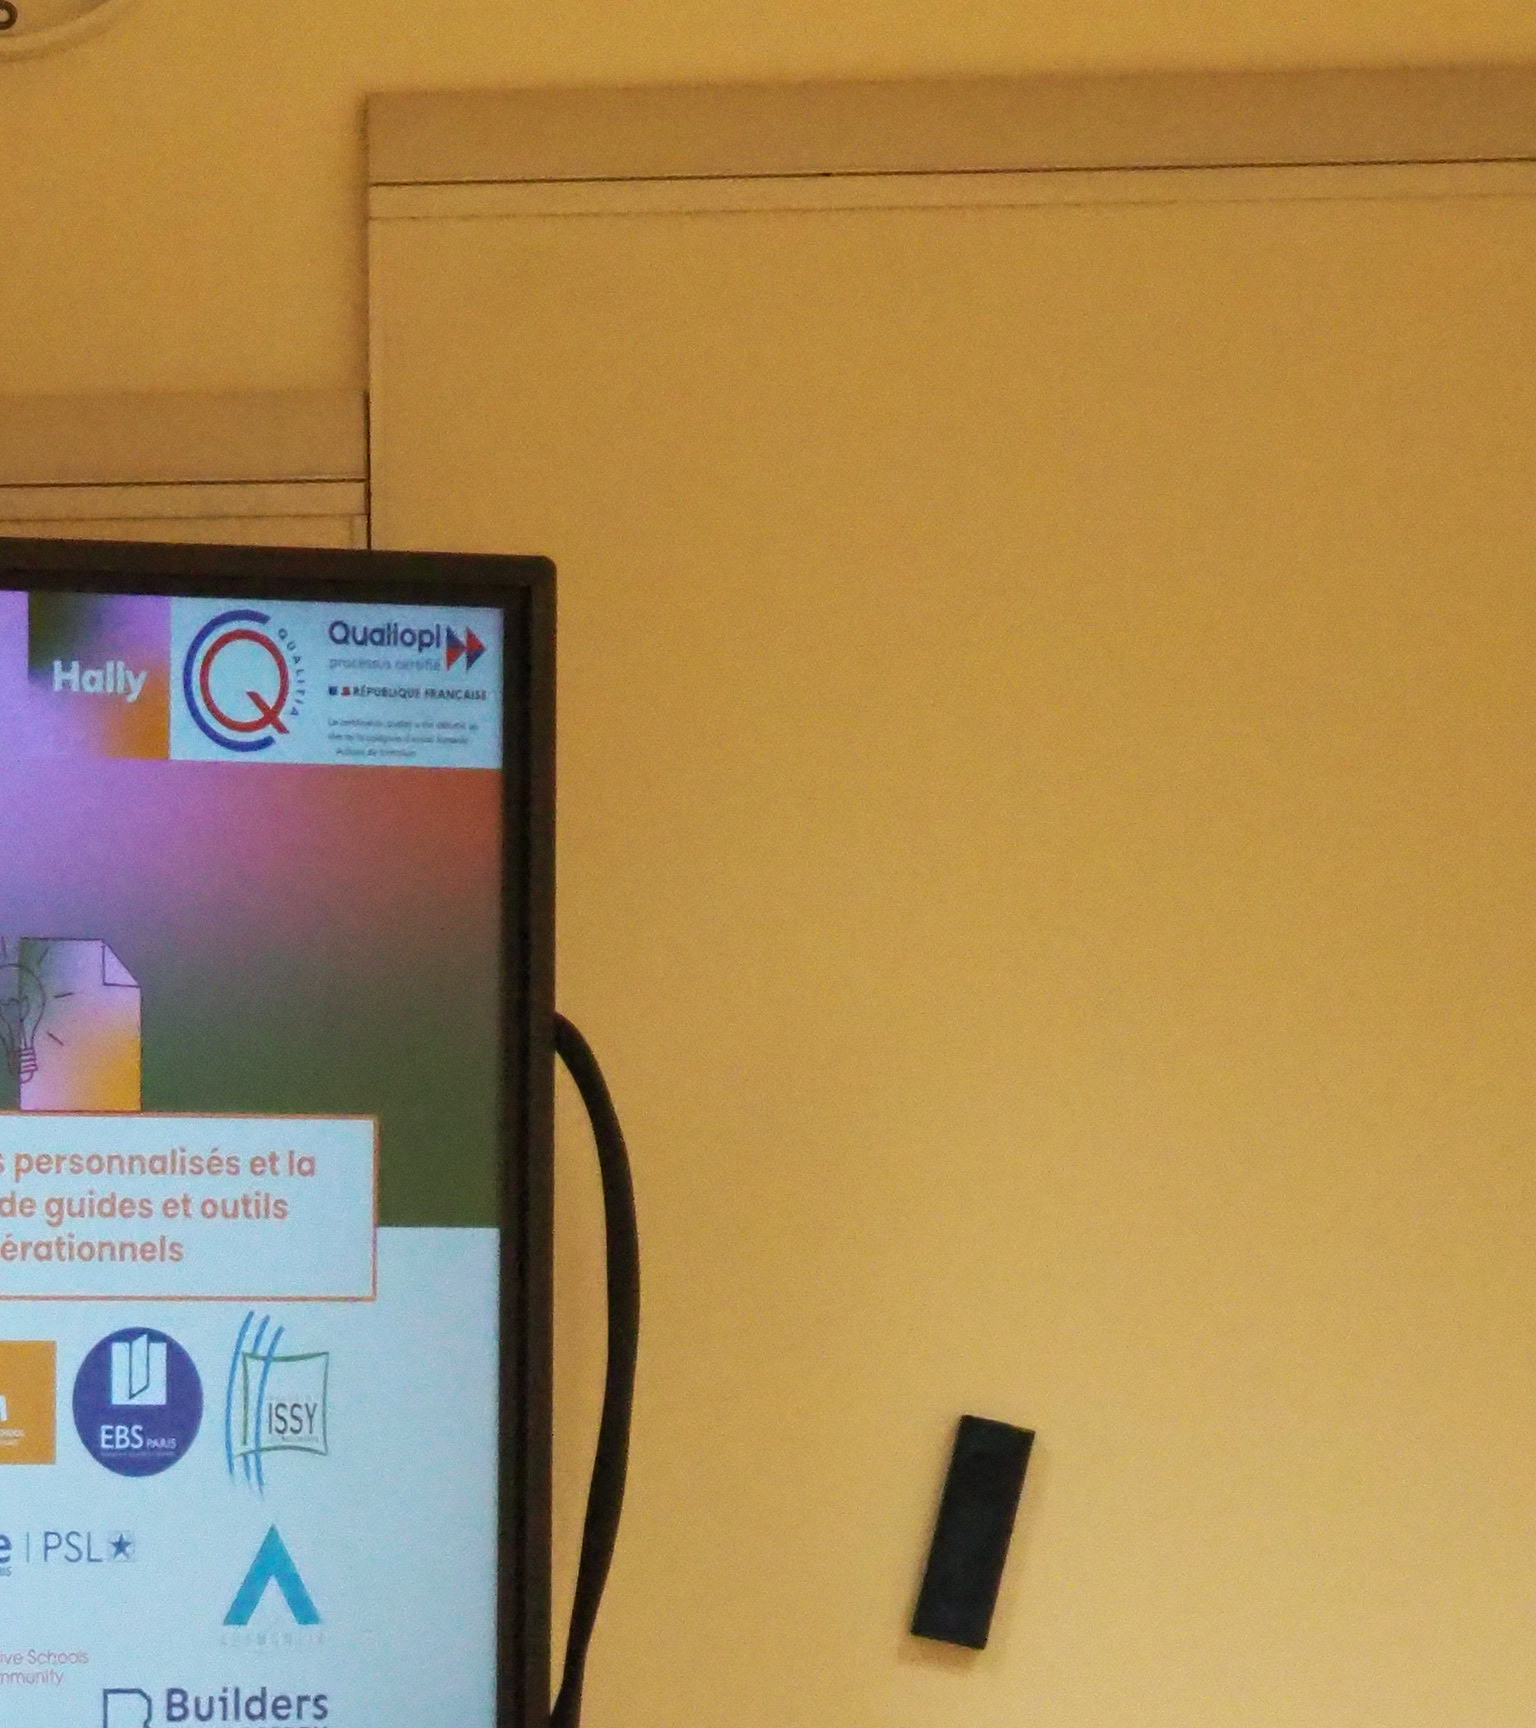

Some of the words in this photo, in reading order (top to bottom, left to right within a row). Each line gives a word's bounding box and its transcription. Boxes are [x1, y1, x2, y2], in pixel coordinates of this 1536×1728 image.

[53, 660, 148, 702] Hally
[14, 1145, 240, 1182] personnalisés
[249, 1150, 279, 1176] et
[288, 1149, 317, 1178] la
[45, 1190, 153, 1228] guides
[162, 1193, 192, 1218] et
[200, 1191, 289, 1220] outils
[268, 1402, 318, 1435] ISSY
[100, 1425, 144, 1449] EBS
[147, 1438, 177, 1449] PARIS
[43, 1531, 104, 1563] PSL
[27, 1649, 90, 1666] Schools
[166, 1686, 329, 1722] Builders
